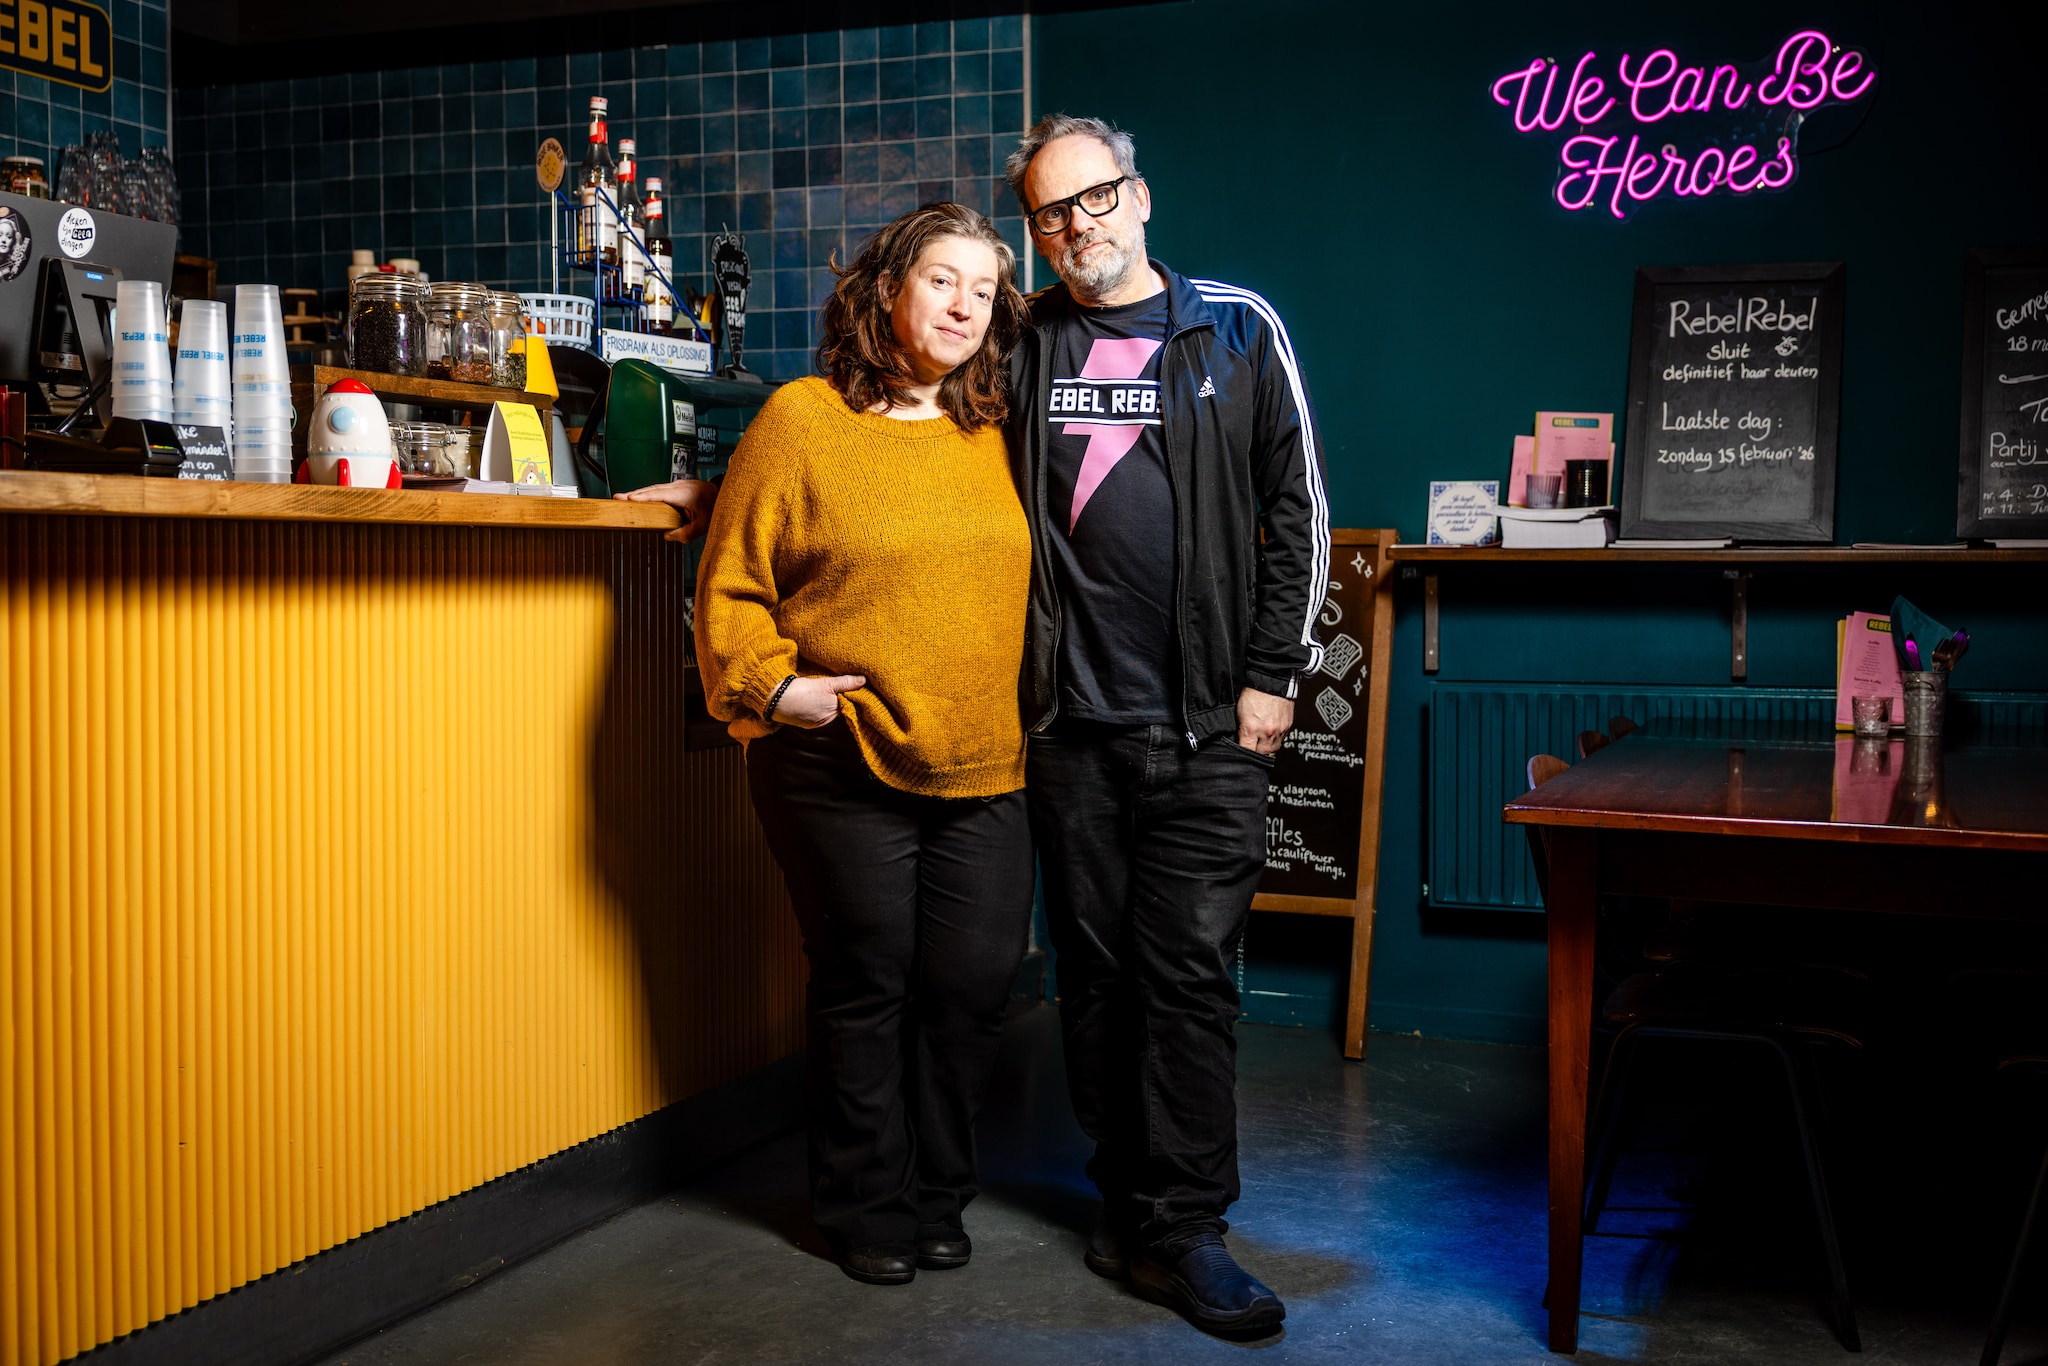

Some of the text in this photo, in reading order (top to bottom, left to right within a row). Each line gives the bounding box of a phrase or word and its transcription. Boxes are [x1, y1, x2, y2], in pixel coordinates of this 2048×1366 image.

[0, 0, 103, 78] EBEL
[1491, 29, 1875, 132] We Can Be
[1556, 134, 1796, 219] Heroes
[242, 333, 266, 343] REBEL
[606, 335, 707, 362] FRISDRANK ALS OPLOSSING!
[2007, 335, 2028, 352] 18
[1662, 362, 1819, 383] definitief haar deuren
[1049, 387, 1160, 414] EBEL REB
[1662, 401, 1730, 431] Laatste
[1718, 448, 1735, 463] 15
[1739, 442, 1796, 466] februari
[1990, 431, 2037, 465] Partij
[178, 470, 201, 479] eker
[2026, 484, 2048, 499] D
[1289, 729, 1341, 745] slagroom,
[1304, 751, 1364, 768] pecannootjes
[1279, 793, 1334, 810] hazelnoten
[1283, 784, 1331, 799] slagroom,
[1265, 816, 1303, 847] ffles
[1315, 863, 1346, 880] wings,
